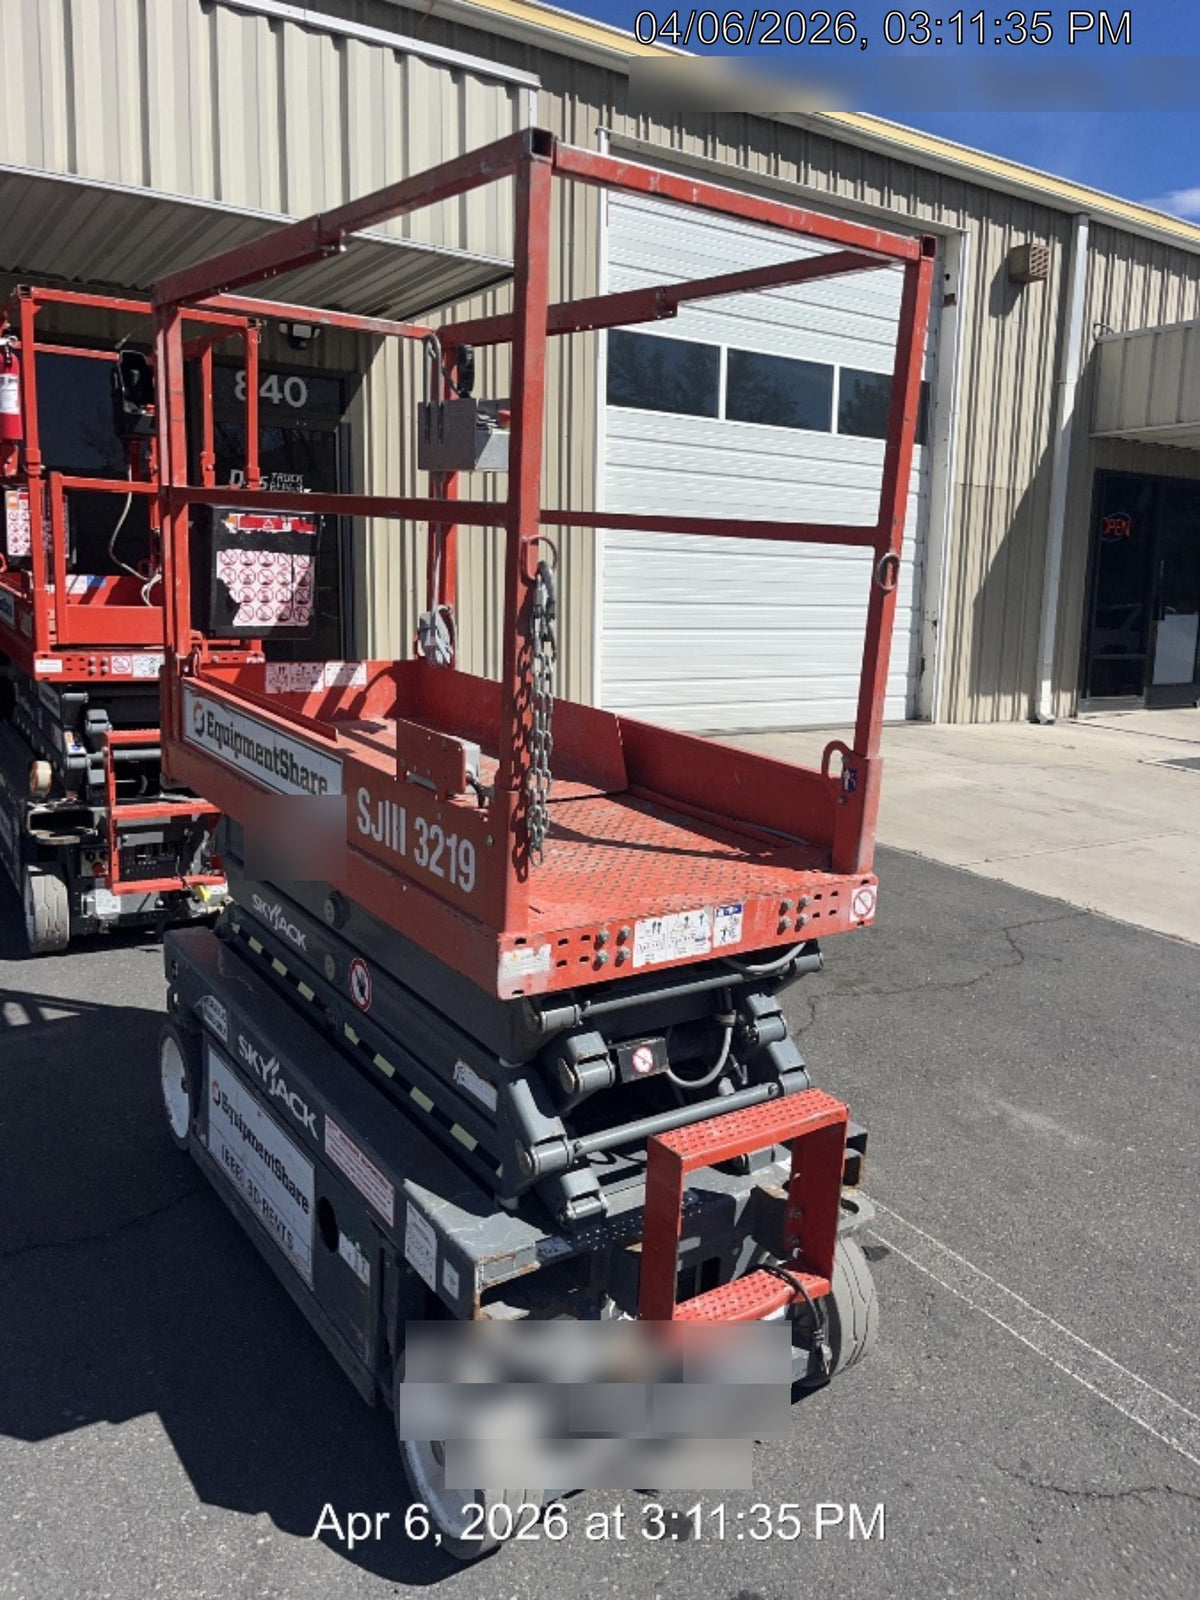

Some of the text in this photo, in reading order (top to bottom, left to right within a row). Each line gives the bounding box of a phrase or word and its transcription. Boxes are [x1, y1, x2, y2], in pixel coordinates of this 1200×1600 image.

[234, 370, 308, 408] 840
[271, 472, 304, 484] TRUCK
[207, 711, 328, 795] EquipmentShare
[357, 787, 476, 893] SJIII 3219
[252, 894, 307, 951] SKYJACK
[238, 1034, 318, 1140] SKYJACK
[219, 1091, 310, 1215] EquipmentShare
